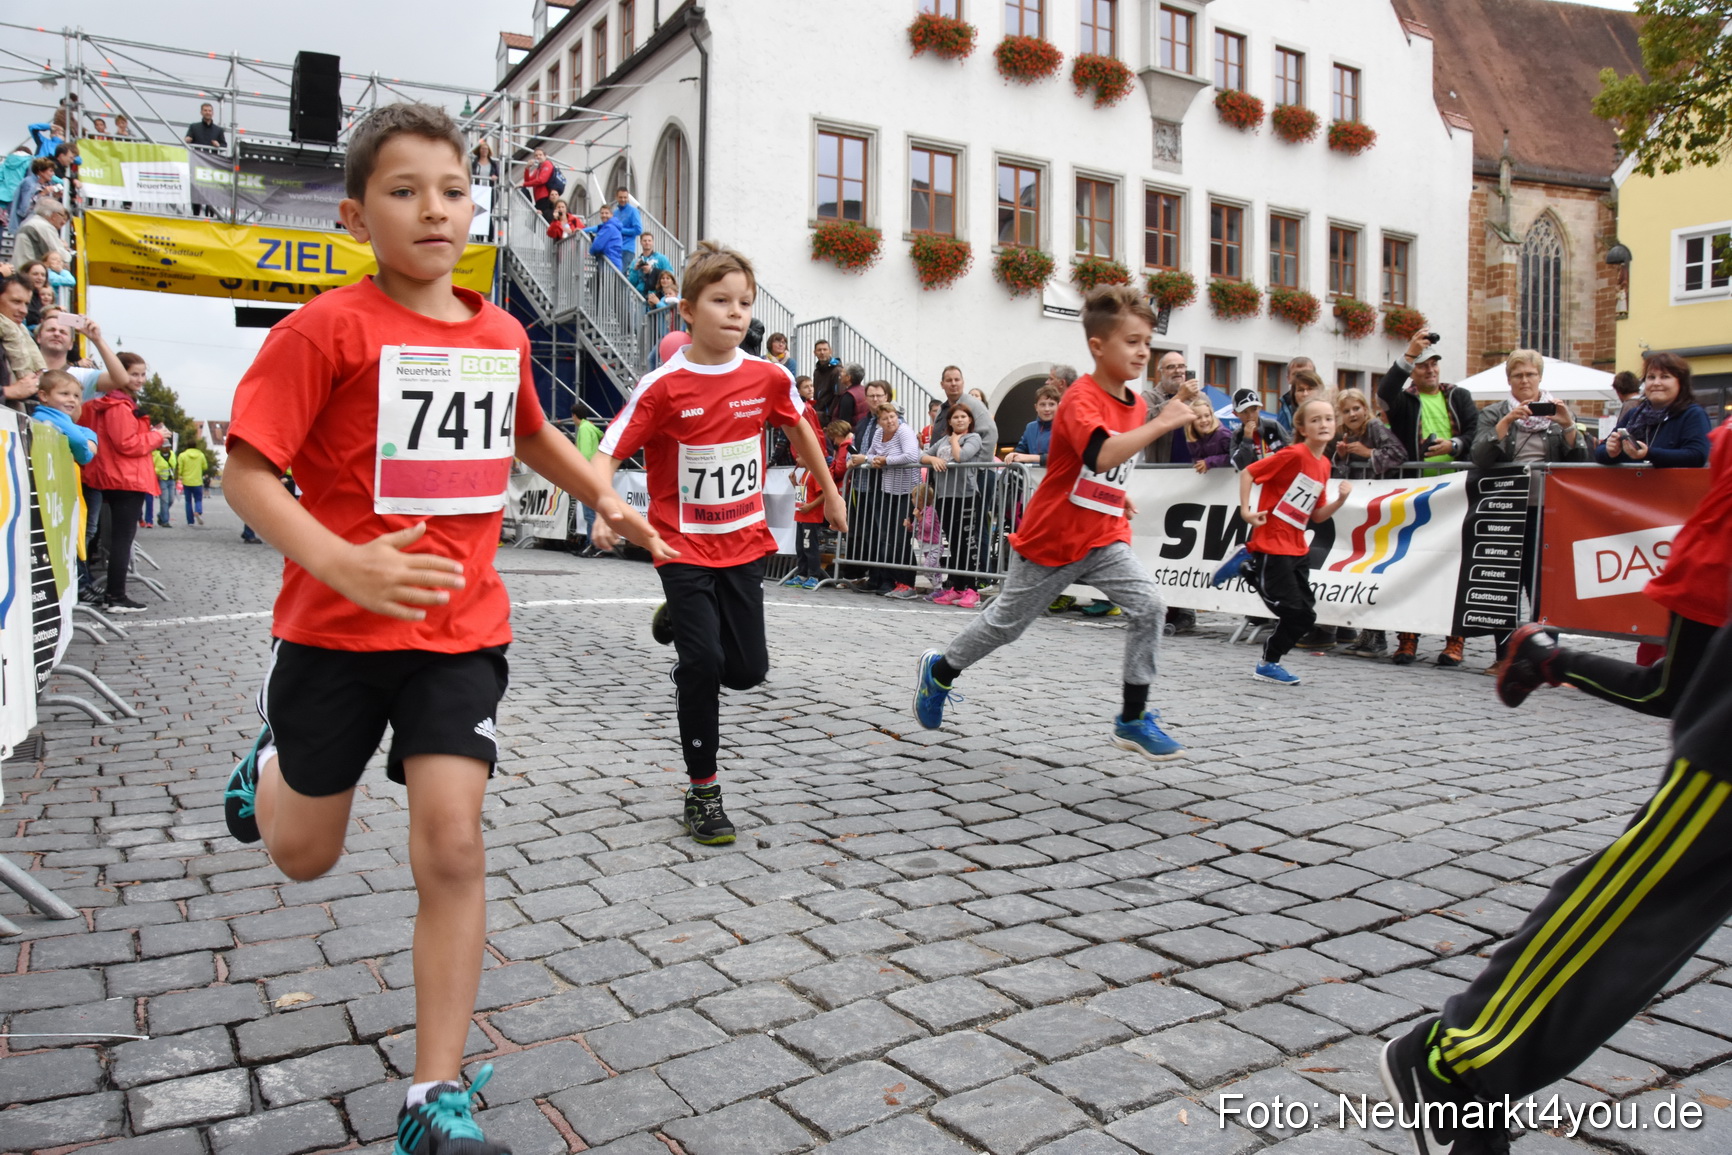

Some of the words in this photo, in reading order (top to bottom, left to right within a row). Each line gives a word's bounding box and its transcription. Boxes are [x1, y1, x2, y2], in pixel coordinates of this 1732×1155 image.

[195, 166, 266, 189] BOCK
[137, 182, 182, 191] NeuerMarkt
[110, 238, 161, 254] Neumarkter
[163, 247, 204, 258] Stadtlauf
[257, 238, 347, 275] ZIEL
[159, 271, 196, 281] Stadtlauf
[461, 355, 517, 375] BOCK
[396, 366, 451, 377] NeuerMarkt
[729, 401, 740, 409] FC
[681, 407, 704, 419] JAKO
[402, 390, 514, 450] 7414
[688, 459, 757, 500] 7129
[1494, 480, 1515, 488] Strom
[1488, 502, 1513, 510] Erdgas
[694, 501, 755, 522] Maximilian
[1485, 548, 1508, 556] Wärme
[1481, 570, 1506, 578] Freizeit
[1471, 592, 1508, 602] Stadtbusse
[1467, 615, 1507, 625] Parkhäuser
